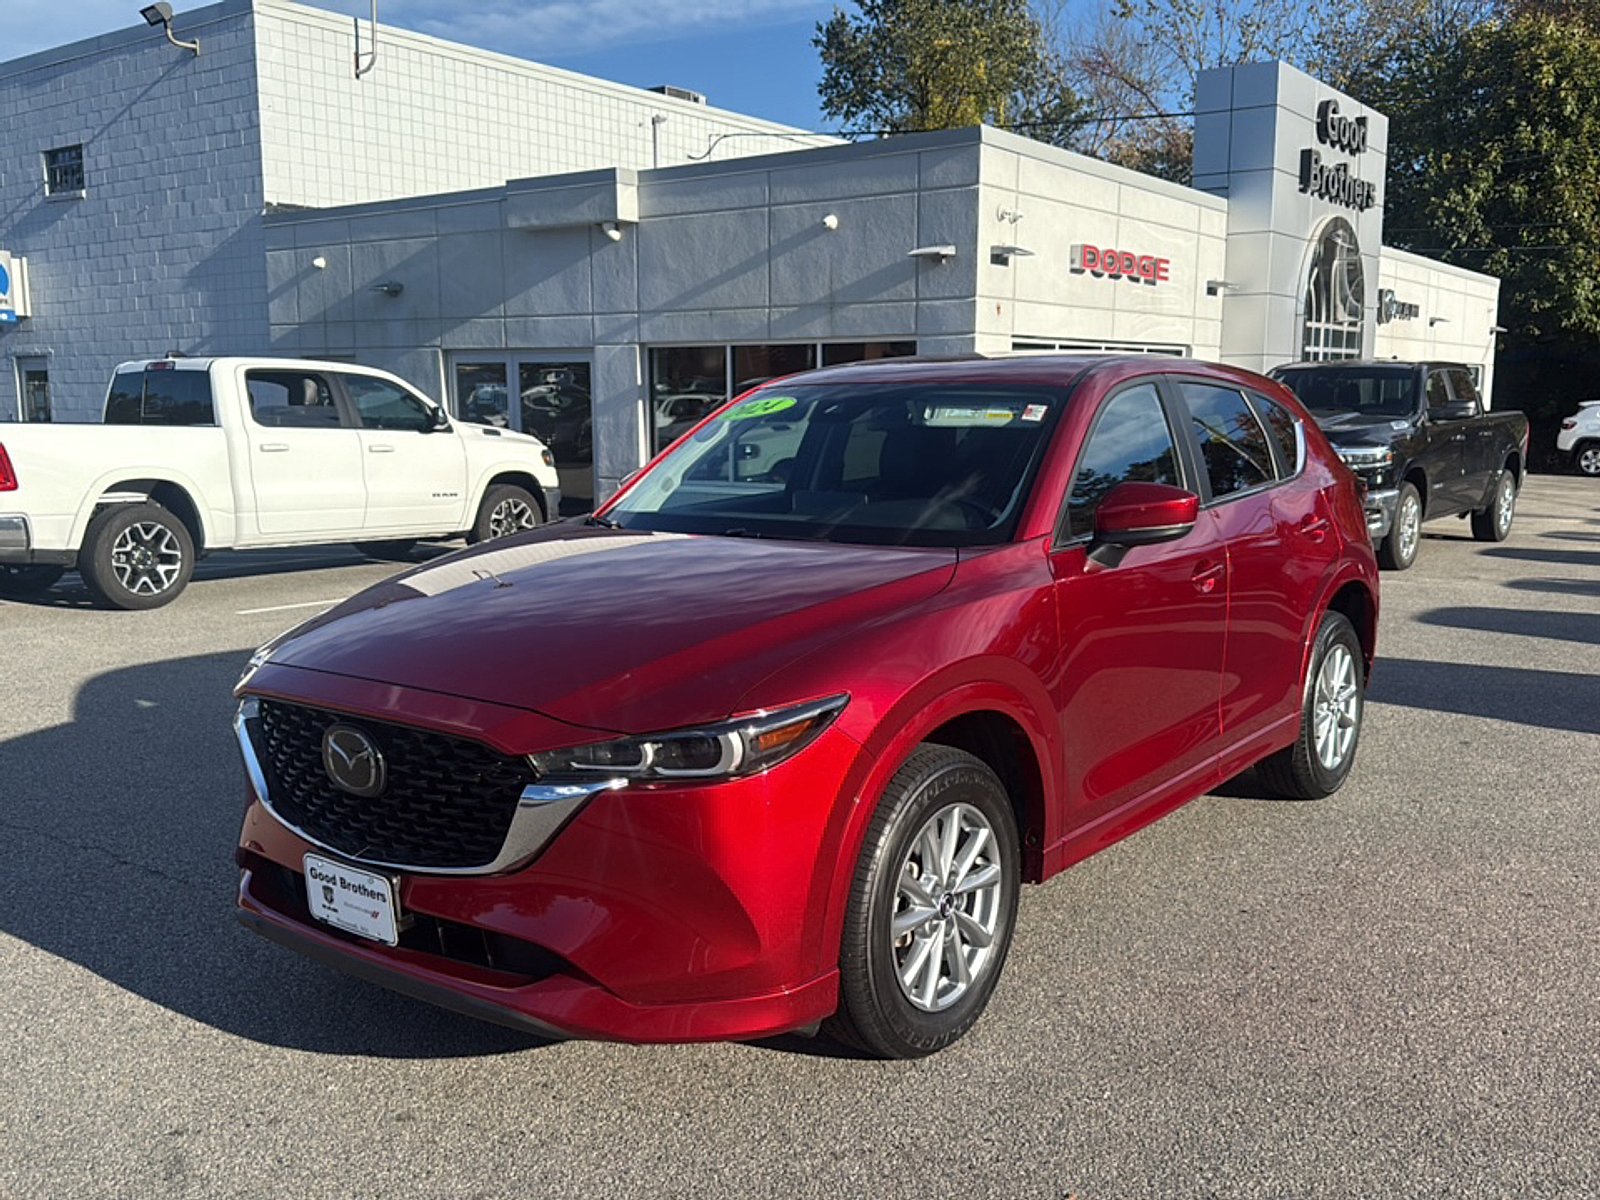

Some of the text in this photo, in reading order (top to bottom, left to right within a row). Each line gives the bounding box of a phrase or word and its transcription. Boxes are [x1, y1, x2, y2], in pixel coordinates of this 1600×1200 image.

[1318, 99, 1368, 155] Good
[1301, 148, 1376, 210] Brothers
[1079, 244, 1170, 281] DODGE
[309, 866, 387, 903] Good Brothers
